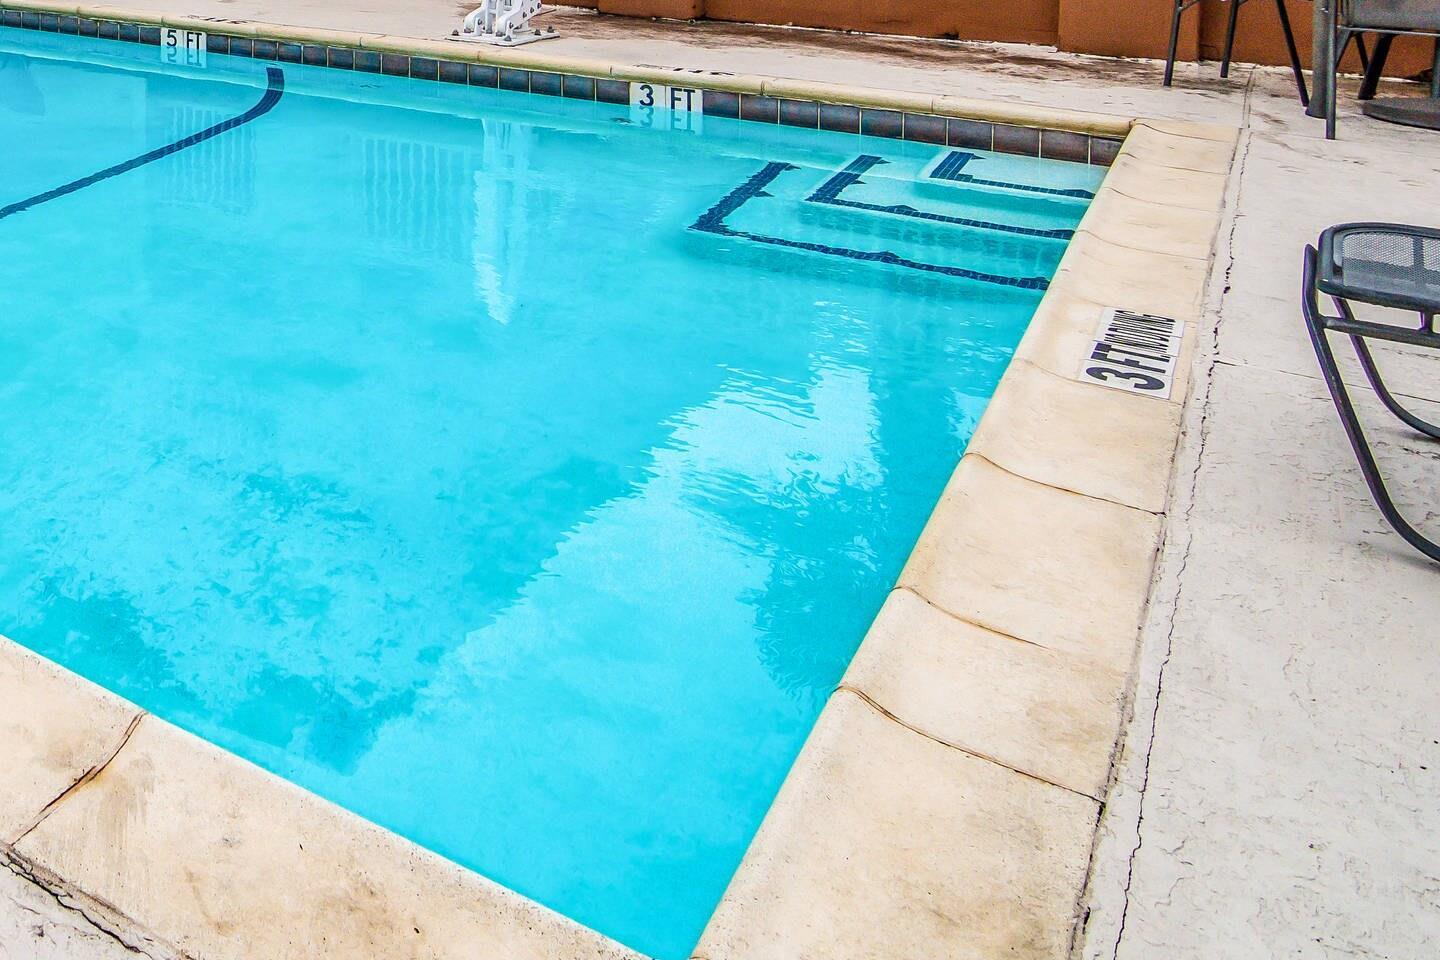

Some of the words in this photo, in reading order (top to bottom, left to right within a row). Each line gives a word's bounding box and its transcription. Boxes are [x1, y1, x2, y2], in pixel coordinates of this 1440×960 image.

[166, 29, 177, 47] 5
[186, 31, 203, 49] FT
[639, 84, 655, 107] 3
[670, 86, 696, 112] FT
[1085, 366, 1166, 391] 3
